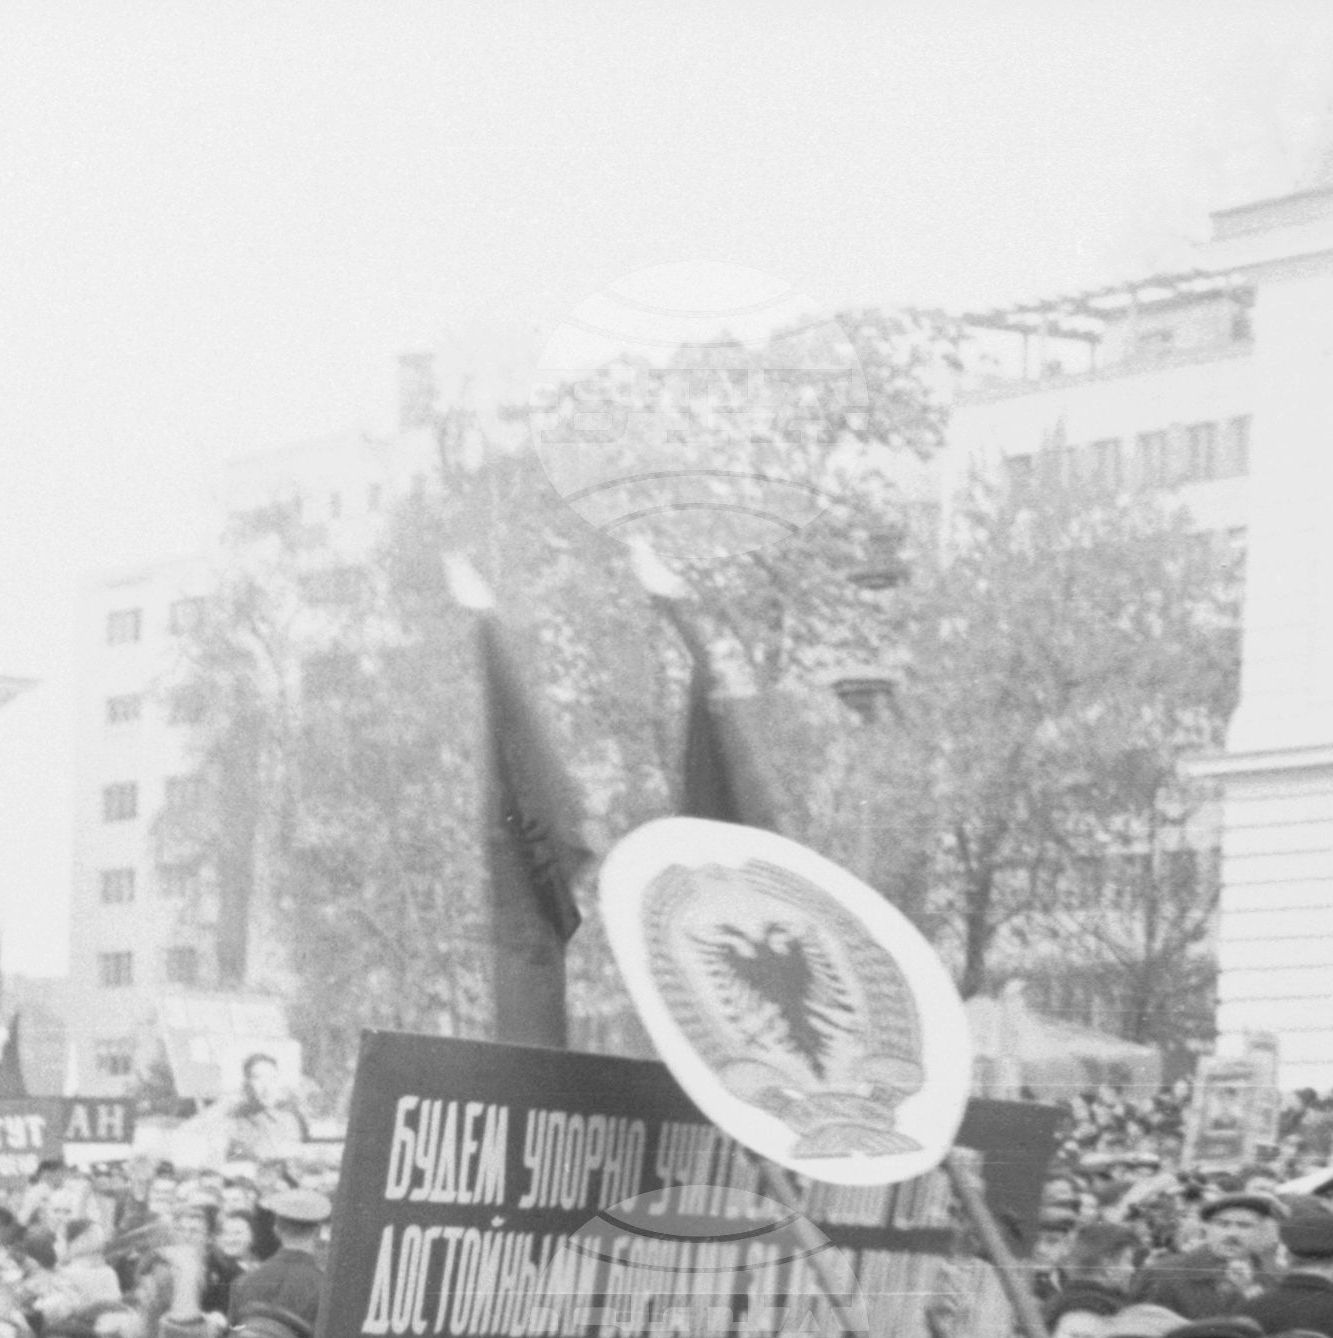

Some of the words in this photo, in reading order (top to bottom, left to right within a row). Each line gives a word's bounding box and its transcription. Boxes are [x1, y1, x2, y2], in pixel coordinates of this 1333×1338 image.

[384, 1095, 509, 1206] БУДЕМ
[518, 1107, 646, 1213] УПОРНО
[361, 1214, 602, 1338] ДОСТОЙНЫМИ
